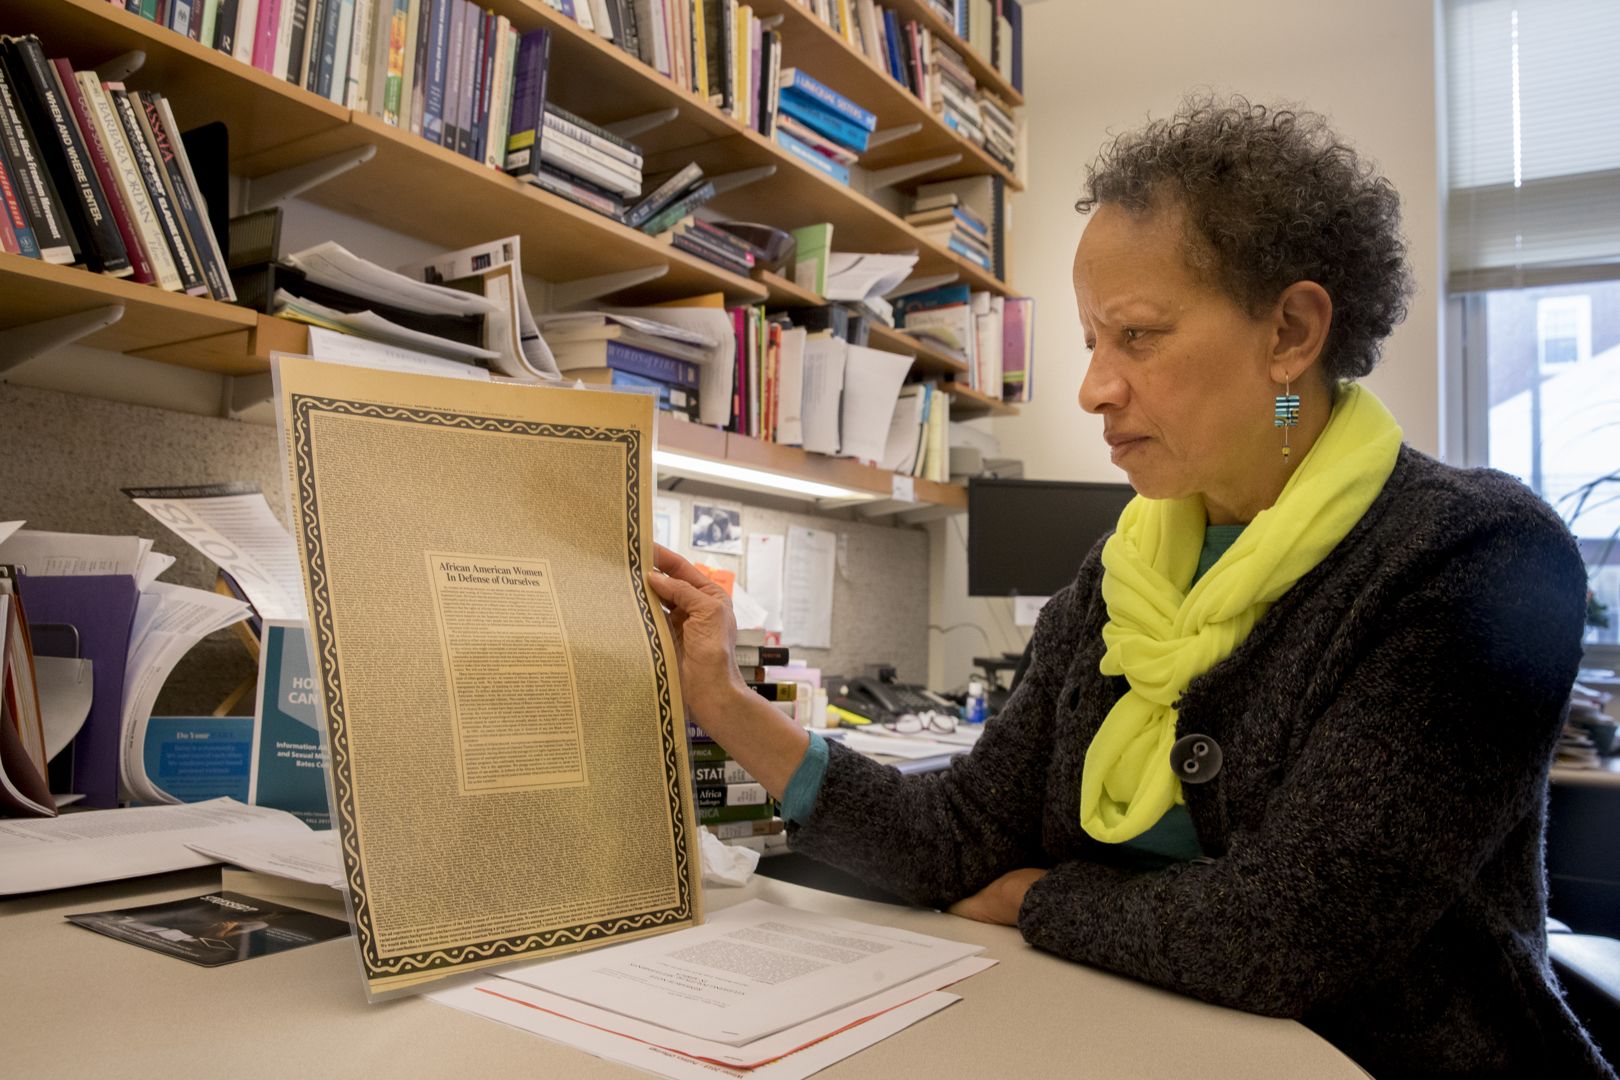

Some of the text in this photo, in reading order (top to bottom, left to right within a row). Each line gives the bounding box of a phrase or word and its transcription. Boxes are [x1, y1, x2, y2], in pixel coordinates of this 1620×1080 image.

[44, 89, 65, 124] WHEN
[57, 122, 73, 146] AND
[66, 144, 87, 182] WHERE
[125, 107, 145, 143] Taste
[140, 97, 176, 163] ASSATA
[0, 81, 61, 240] Baker and the Black Freedom Movement
[96, 100, 154, 225] BARBARA JORDAN
[139, 141, 151, 159] of
[144, 155, 167, 197] Power
[159, 196, 178, 236] ELAINE
[174, 234, 194, 275] BROWN
[440, 562, 542, 577] African American Women
[446, 572, 540, 587] In Defense of Ourselves
[288, 692, 320, 704] CAN
[276, 742, 317, 750] Information
[700, 788, 722, 798] Africa
